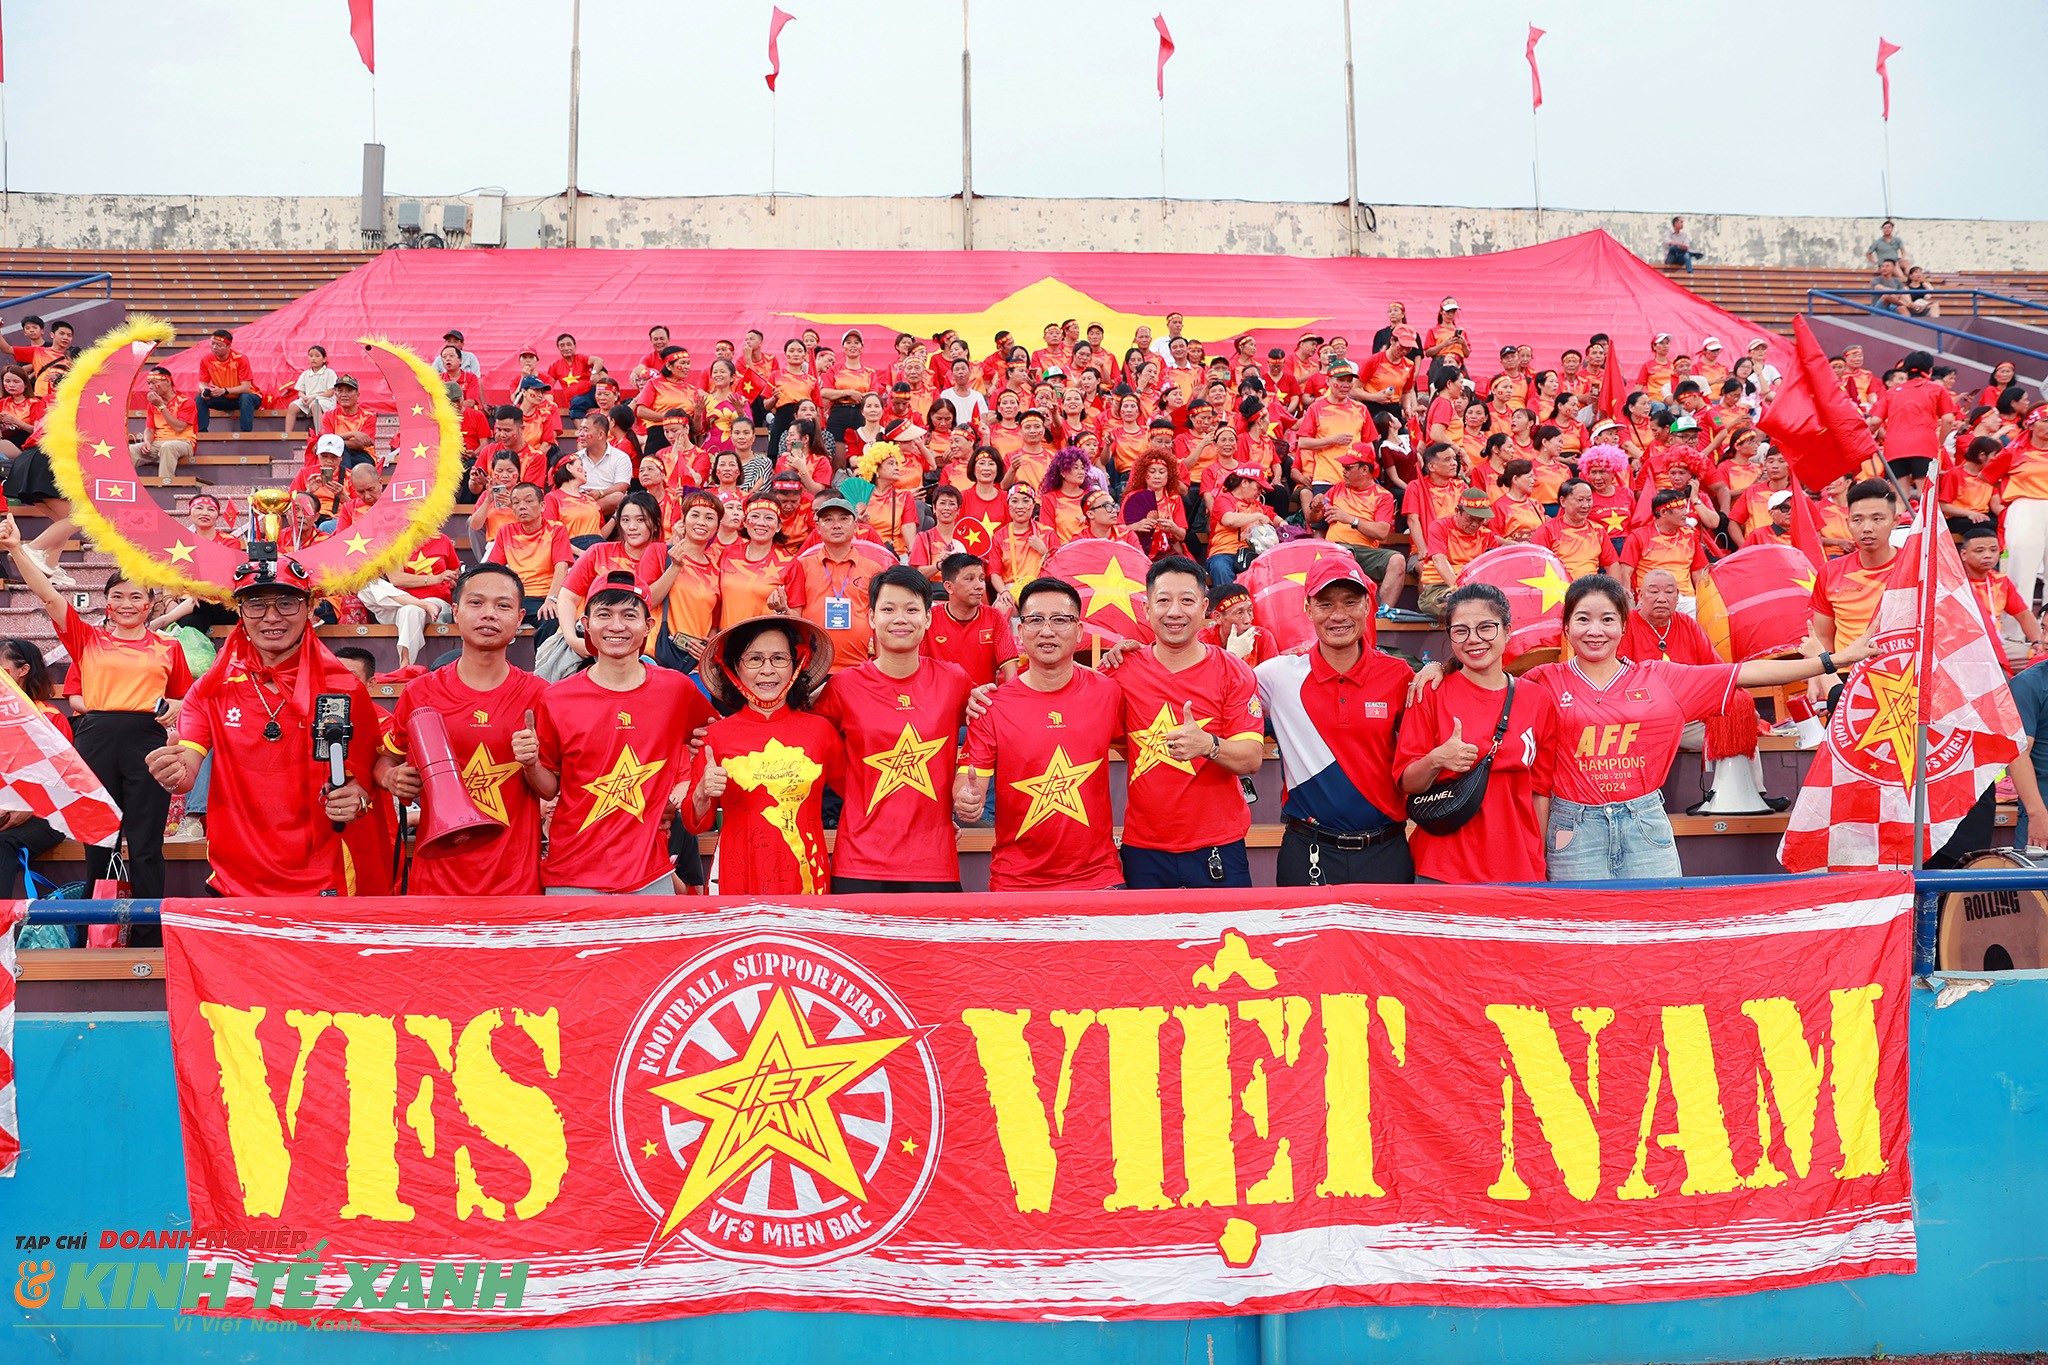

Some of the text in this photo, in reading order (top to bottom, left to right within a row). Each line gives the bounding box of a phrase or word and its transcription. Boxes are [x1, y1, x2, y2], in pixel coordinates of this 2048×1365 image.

[76, 595, 86, 607] F
[1573, 722, 1641, 758] AFF
[1575, 756, 1646, 771] HAMPIONS
[1925, 732, 1967, 773] FS MIEN
[890, 764, 921, 783] NAM
[1590, 772, 1609, 780] 2008
[1614, 771, 1632, 779] 2018
[1040, 787, 1076, 811] NAM
[1413, 790, 1454, 805] CHANEL
[1600, 782, 1627, 792] 2024
[1963, 890, 2021, 921] ROLLING
[136, 965, 147, 973] 17
[637, 952, 887, 1076] FOOTBALL SUPPORTERS
[199, 1001, 570, 1222] VFS
[1484, 983, 1890, 1203] NAM
[722, 1099, 826, 1158] NAM
[707, 1204, 873, 1248] VFS MIEN BAC
